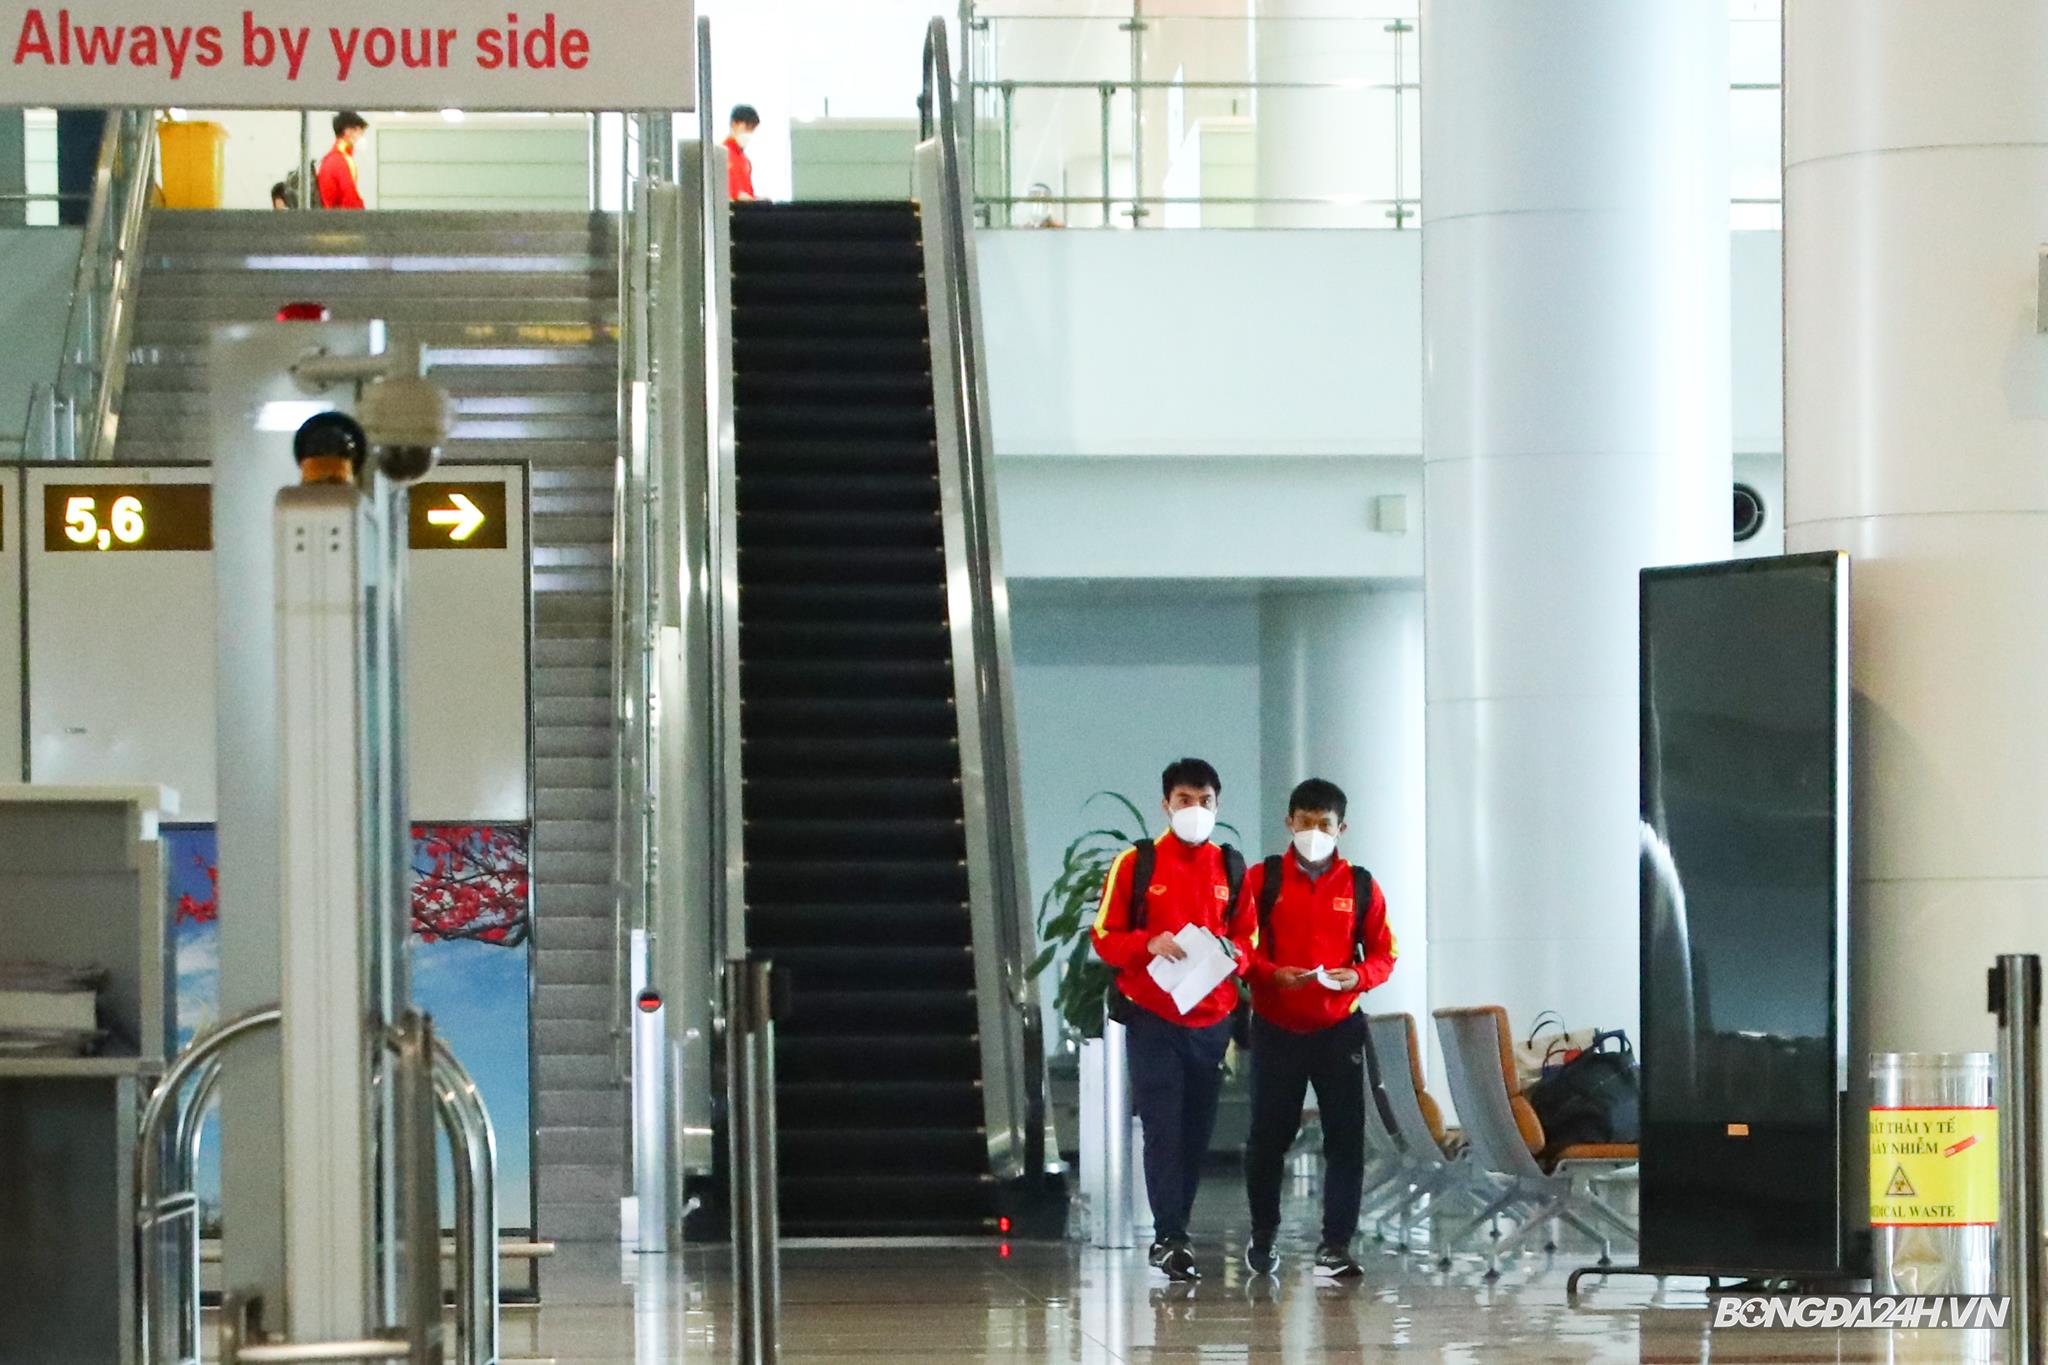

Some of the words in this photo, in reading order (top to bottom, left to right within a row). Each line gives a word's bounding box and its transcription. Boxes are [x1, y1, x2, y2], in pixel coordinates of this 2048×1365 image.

[13, 9, 223, 80] Always
[243, 11, 310, 80] by
[328, 27, 457, 81] your
[476, 12, 590, 69] side
[64, 495, 145, 551] 5,6
[1923, 1121, 1933, 1134] Y
[1909, 1205, 1955, 1218] WASTE
